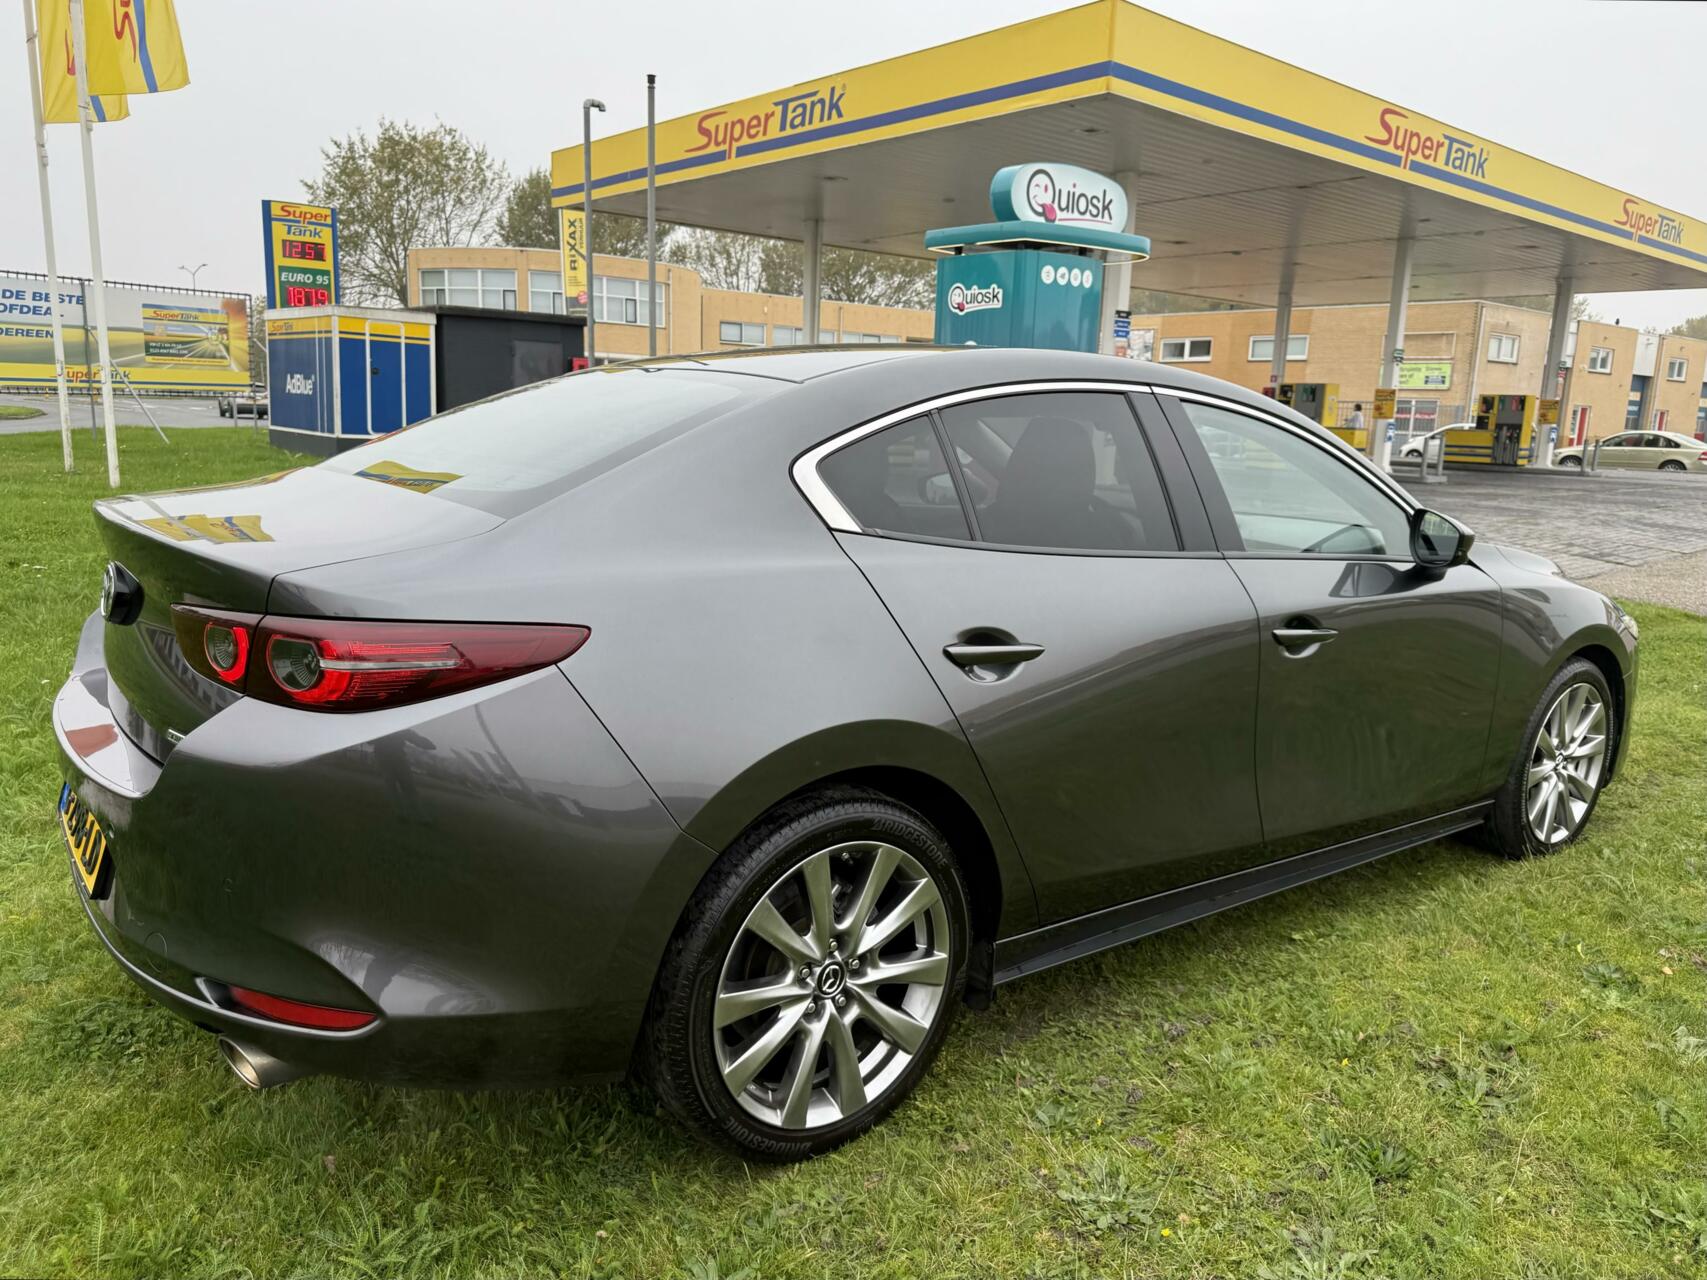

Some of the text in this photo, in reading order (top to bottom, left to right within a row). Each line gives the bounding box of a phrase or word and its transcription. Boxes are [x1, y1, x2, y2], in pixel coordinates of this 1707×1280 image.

[1027, 168, 1113, 222] Quiosk
[279, 204, 331, 225] Super
[282, 223, 323, 239] Tank
[280, 271, 330, 285] EURO 95
[1, 288, 84, 306] DE BESTE
[950, 284, 1001, 312] Quiosk
[0, 302, 64, 318] OFDEA
[871, 817, 949, 869] BRIDGESTONE
[721, 1115, 812, 1154] BRIDGESTONE
